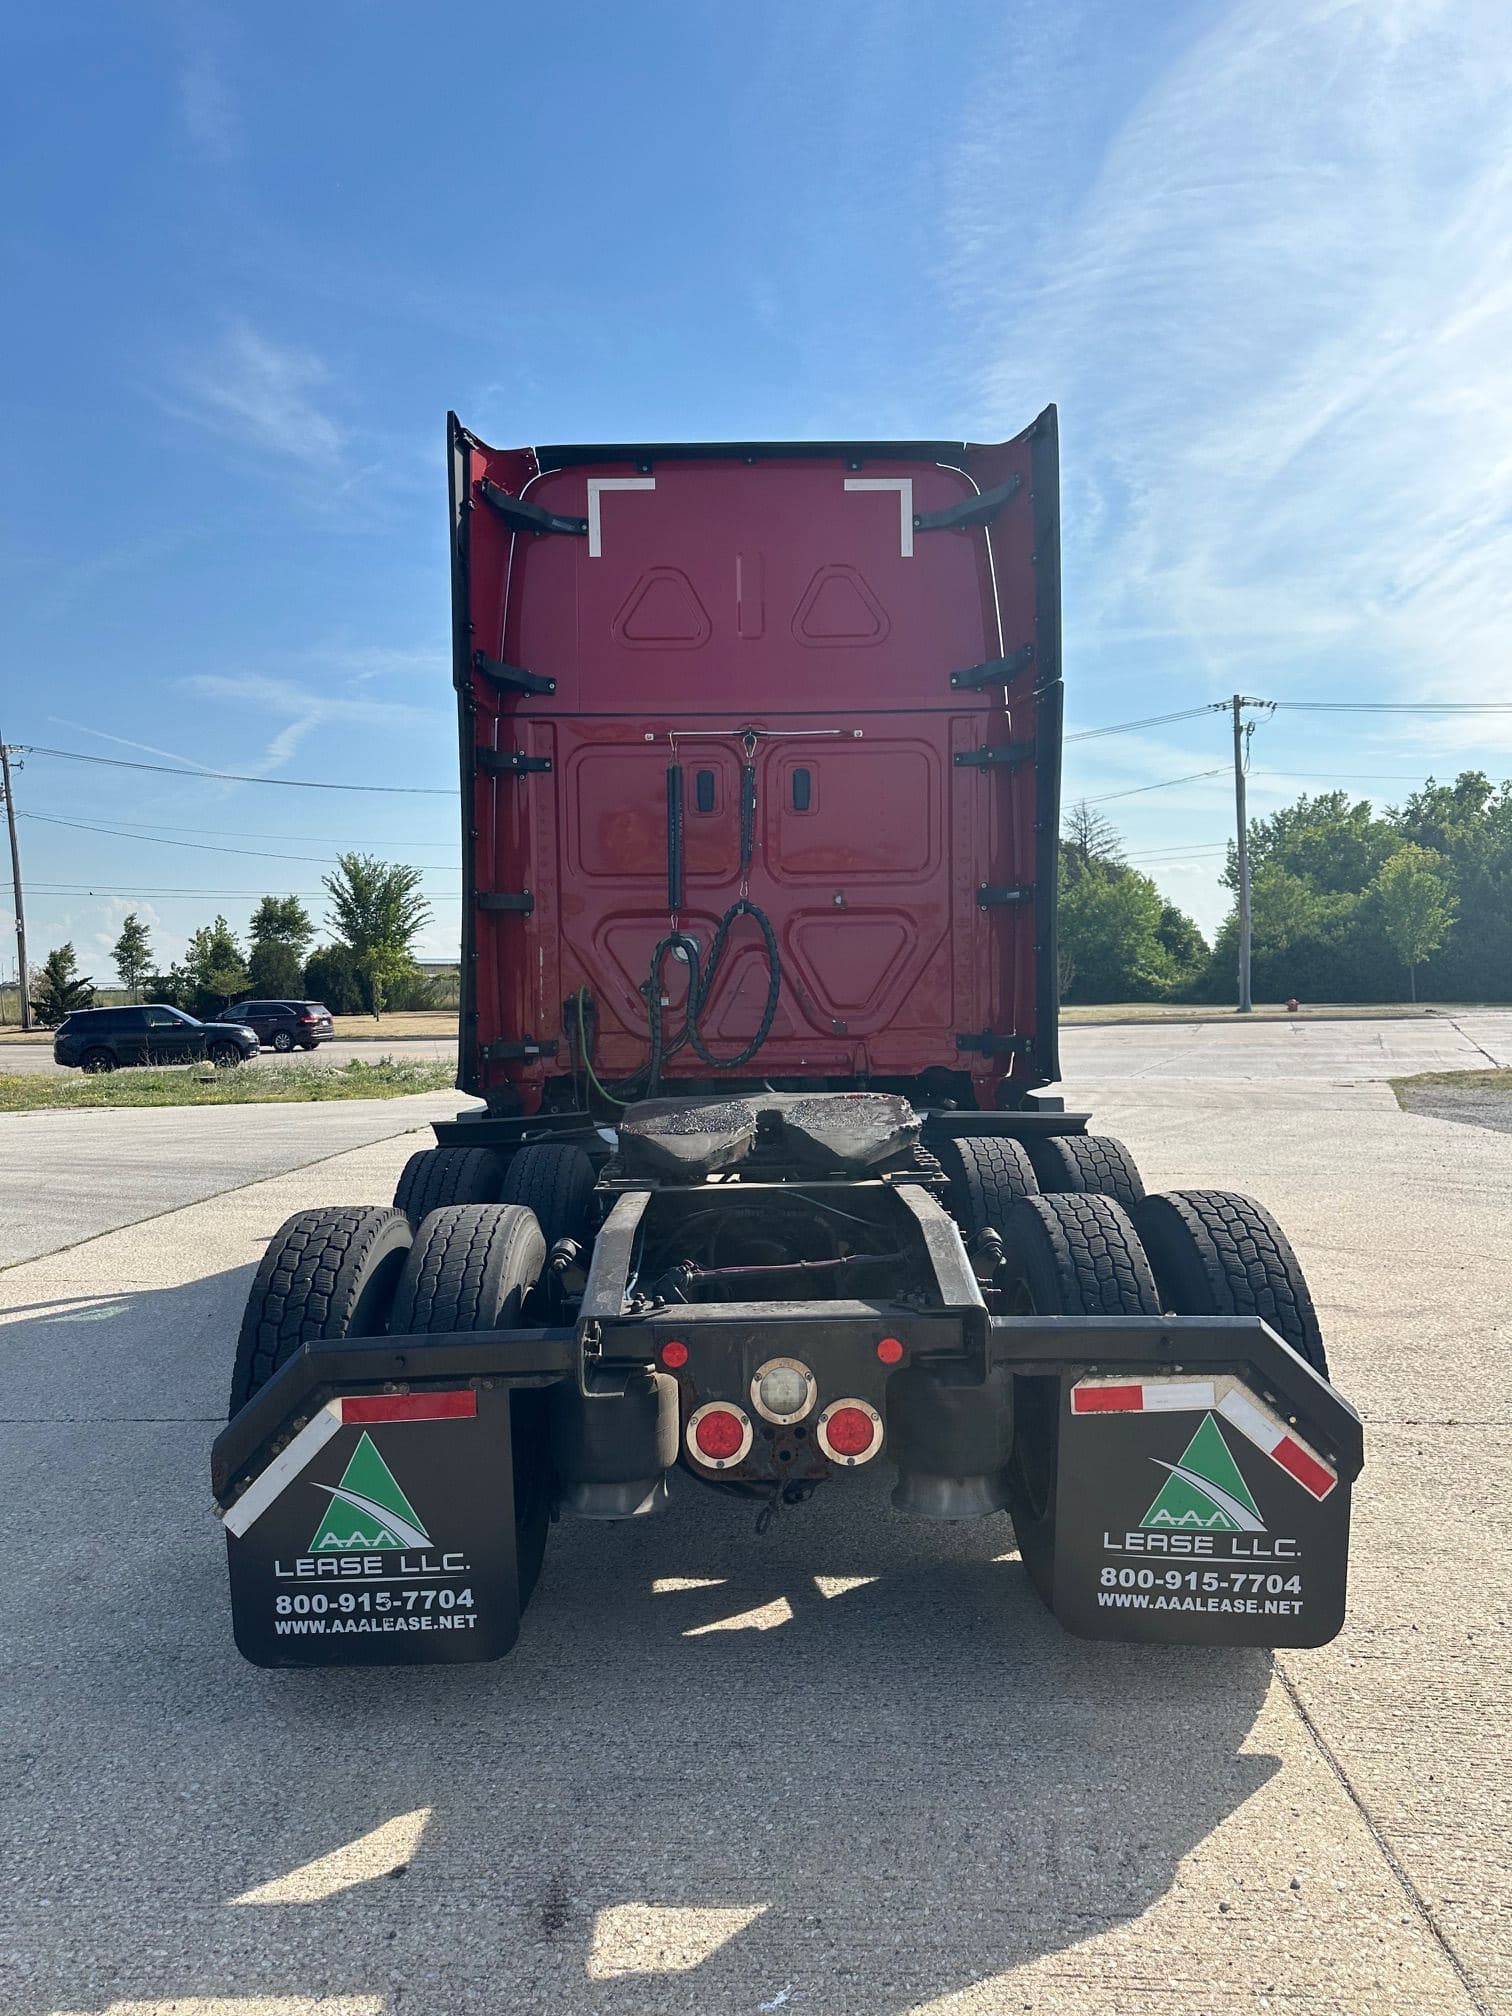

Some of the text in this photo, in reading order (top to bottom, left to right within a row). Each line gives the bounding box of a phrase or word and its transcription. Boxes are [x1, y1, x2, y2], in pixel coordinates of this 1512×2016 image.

[1150, 1508, 1231, 1527] AAA
[317, 1530, 398, 1549] AAA
[1103, 1532, 1302, 1557] LEASE LLC.
[274, 1553, 471, 1577] LEASE LLC.
[1100, 1567, 1302, 1594] 800-915-7704
[275, 1588, 475, 1615] 800-915-7704
[1097, 1592, 1304, 1615] WWW.AAALEASE.NET
[274, 1614, 478, 1635] WWW.AAALEASE.NET
